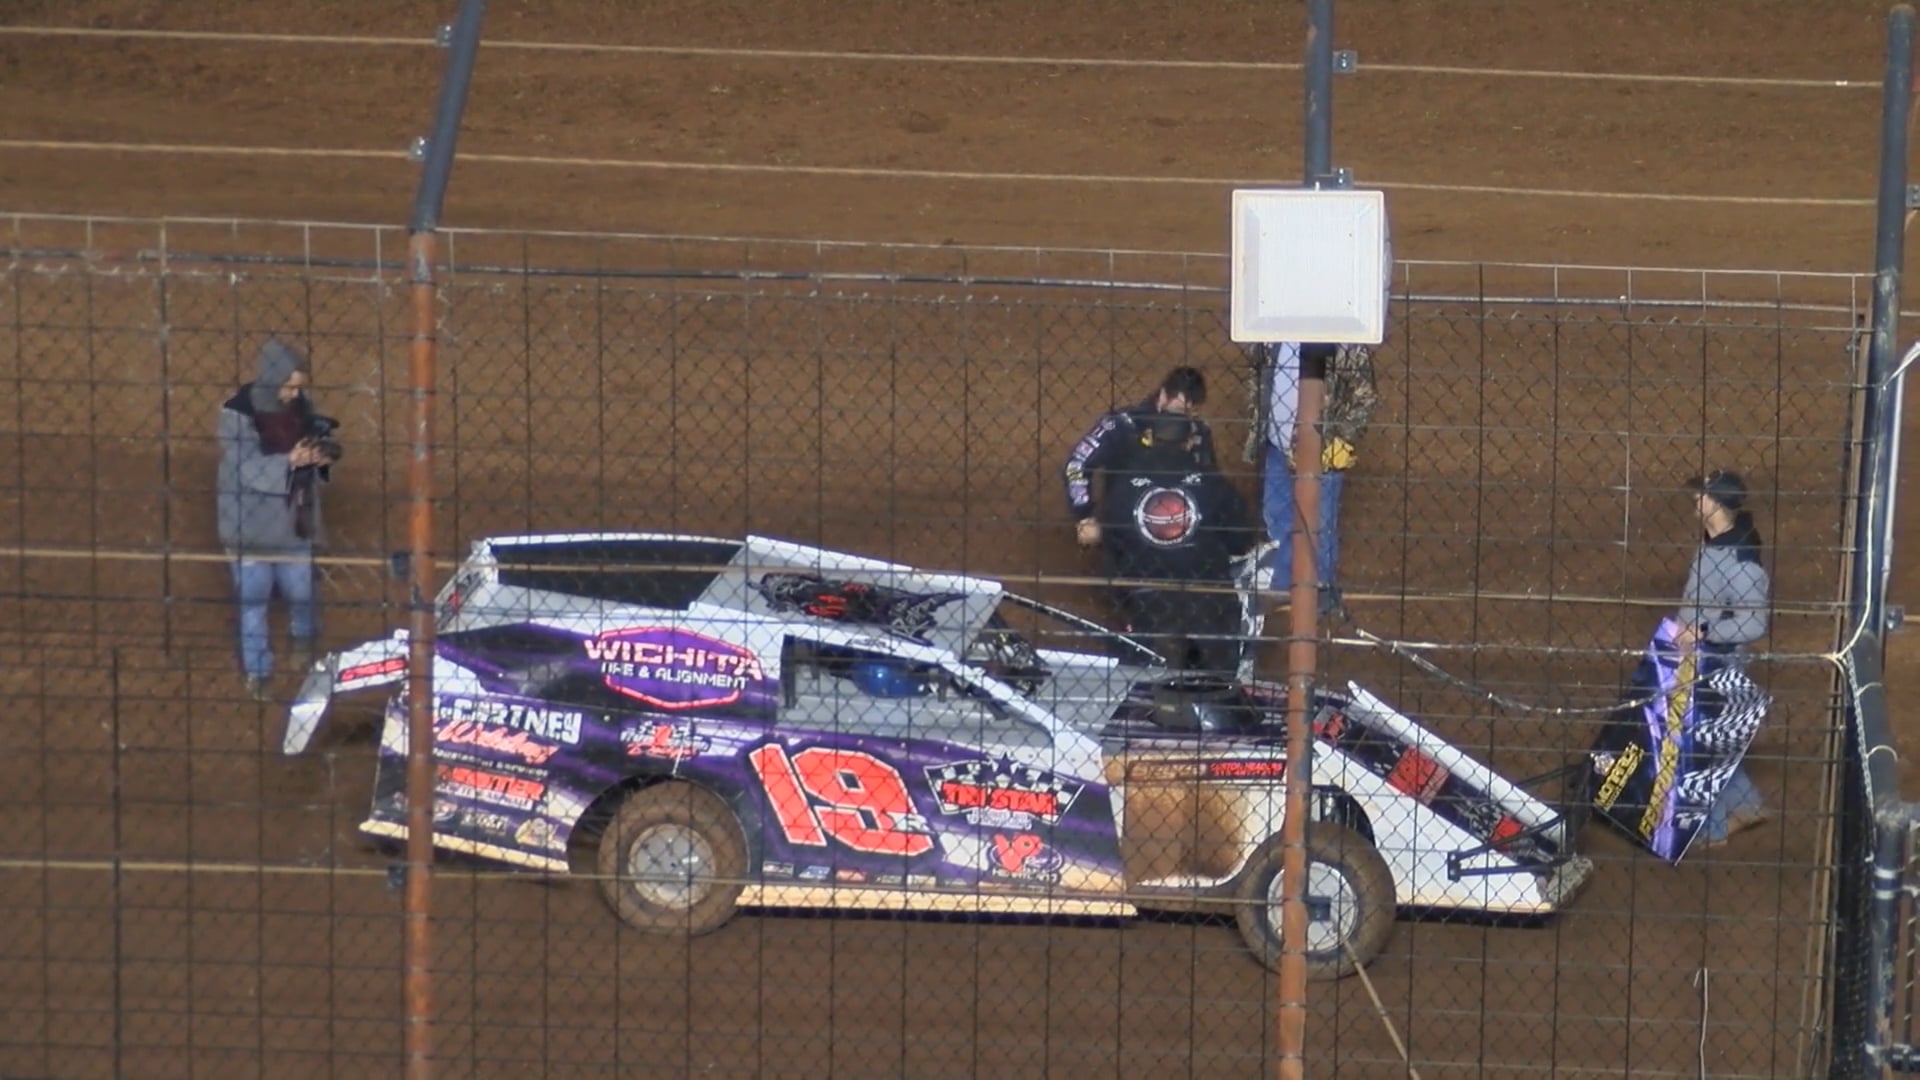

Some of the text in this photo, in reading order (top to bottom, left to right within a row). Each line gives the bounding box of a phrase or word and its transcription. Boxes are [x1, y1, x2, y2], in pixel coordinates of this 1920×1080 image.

[584, 640, 763, 681] WICHITA
[638, 665, 651, 679] &
[655, 667, 748, 689] ALIGNMENT
[942, 781, 1059, 815] TRI STAR
